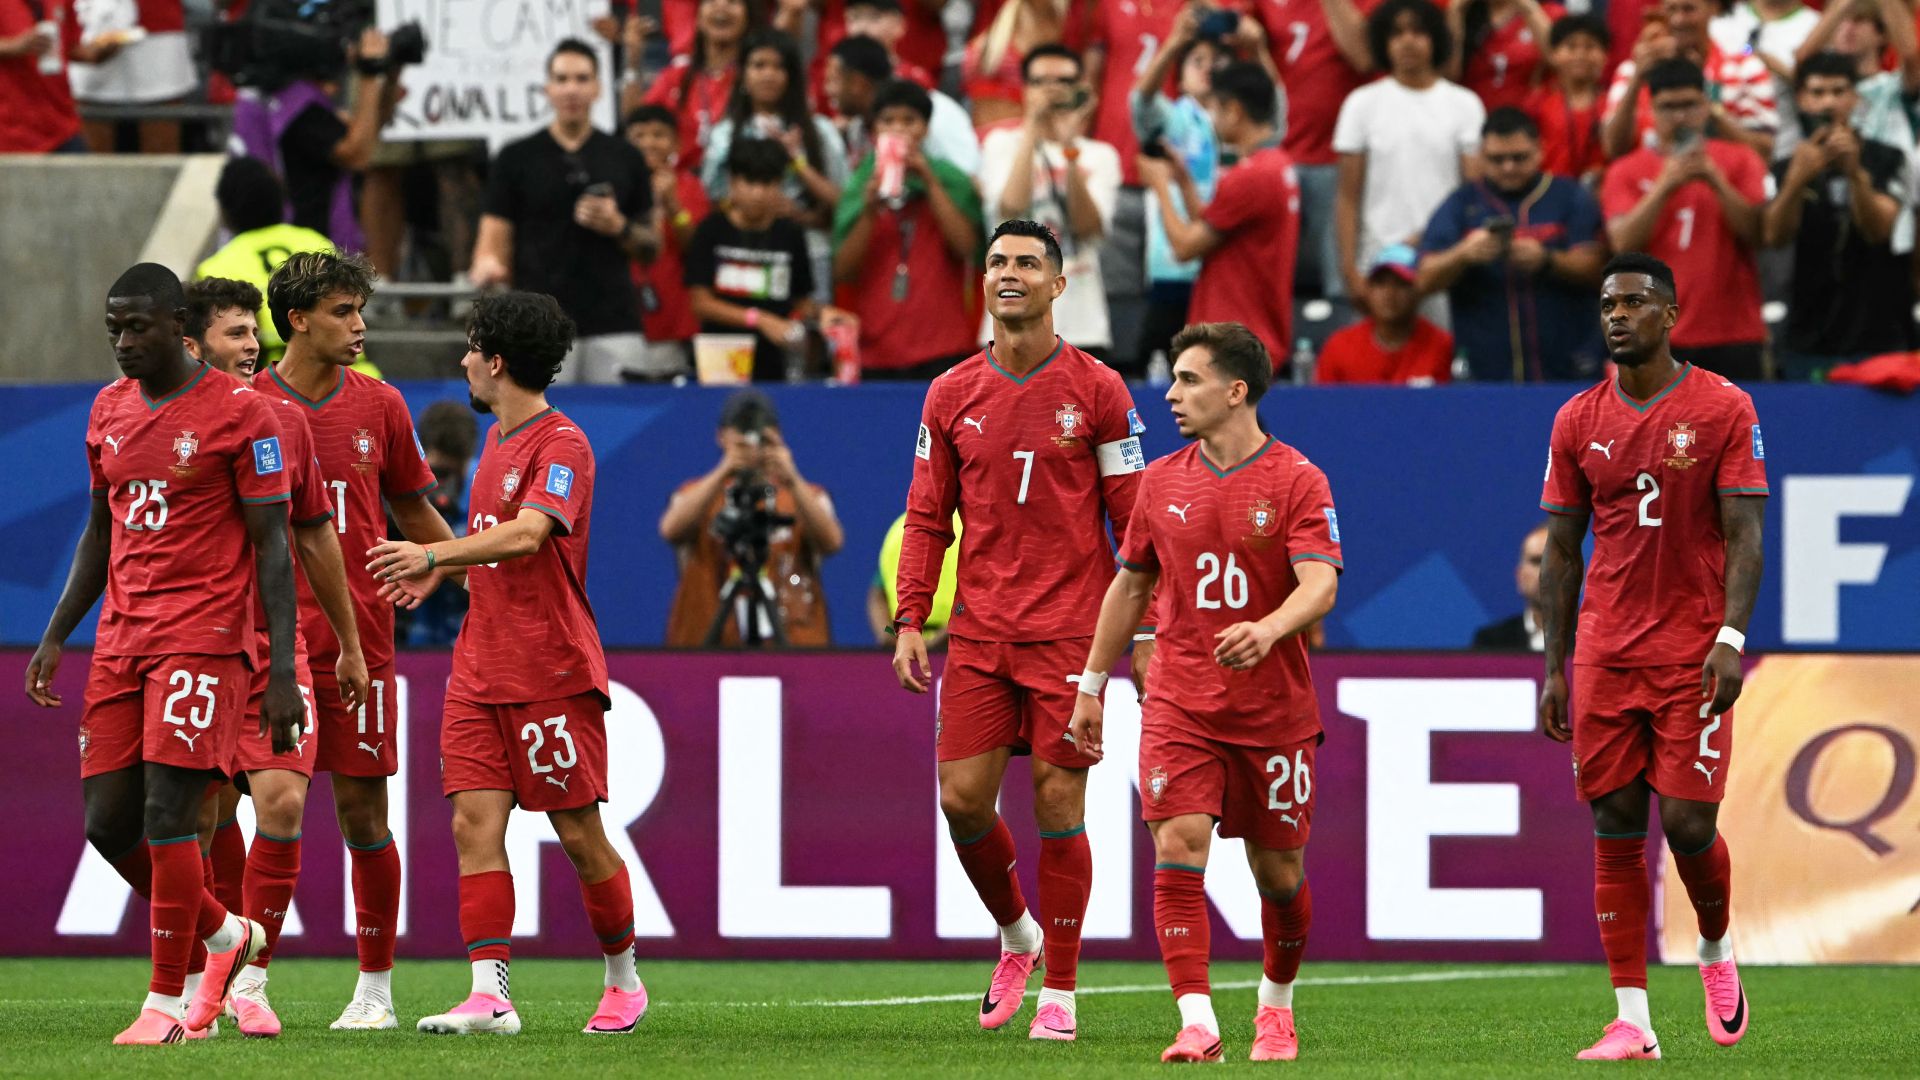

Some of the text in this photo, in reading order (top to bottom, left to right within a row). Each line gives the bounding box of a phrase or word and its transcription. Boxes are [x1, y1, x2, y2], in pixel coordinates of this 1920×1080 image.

[480, 0, 592, 51] CAM
[1284, 22, 1309, 62] 7
[398, 83, 549, 129] ONALD
[1013, 450, 1034, 504] 7
[1637, 472, 1663, 527] 2
[125, 479, 169, 531] 25
[323, 480, 347, 534] 1
[1196, 552, 1249, 609] 26
[1783, 474, 1914, 643] F
[163, 669, 219, 729] 25
[521, 713, 577, 775] 23
[1699, 702, 1720, 758] 2
[1266, 749, 1311, 810] 26
[56, 675, 1544, 940] RLNE
